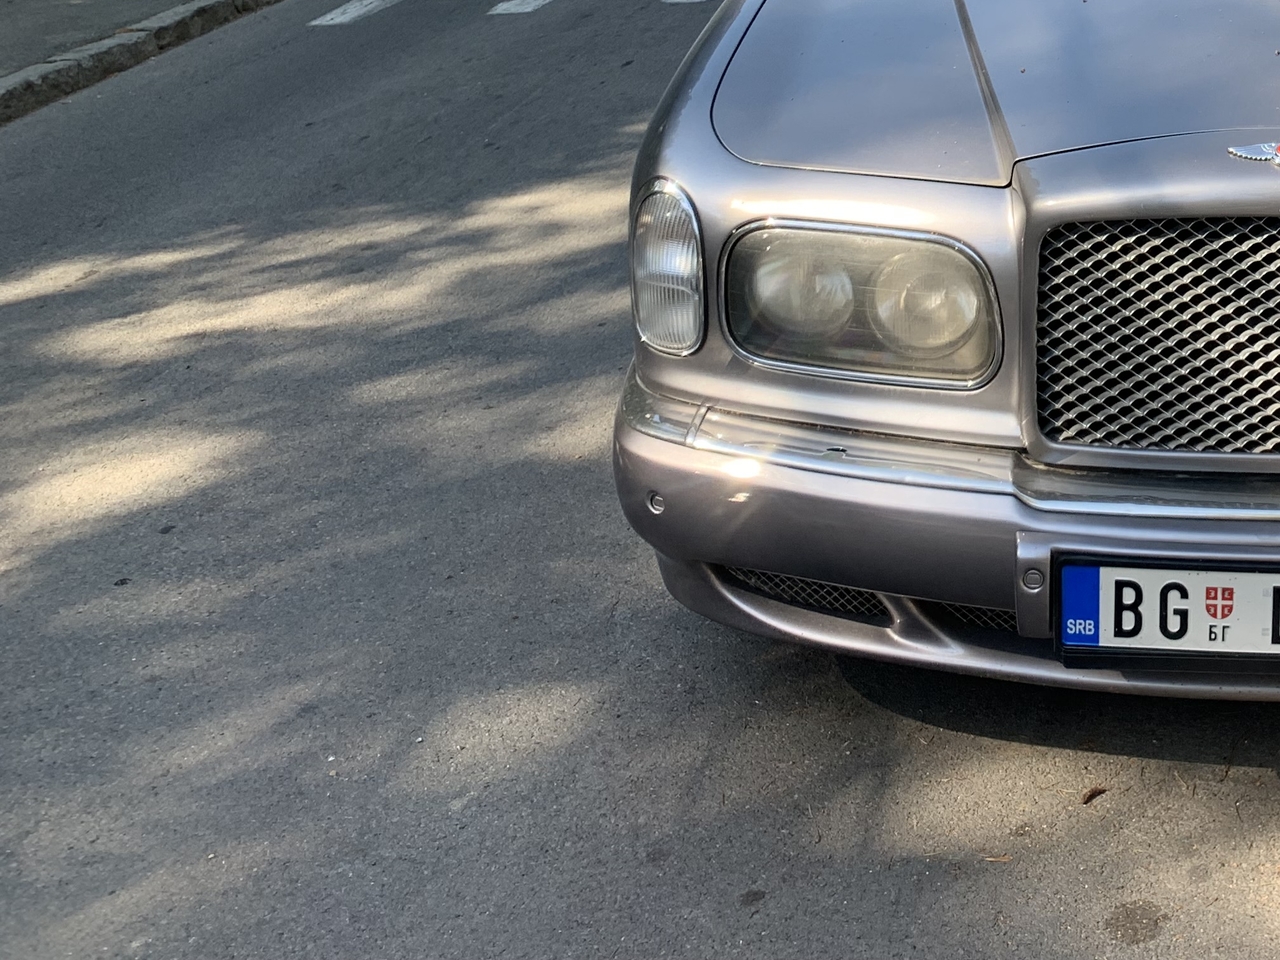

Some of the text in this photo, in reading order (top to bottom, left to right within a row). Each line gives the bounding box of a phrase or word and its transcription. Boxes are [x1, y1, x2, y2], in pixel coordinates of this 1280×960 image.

[1113, 578, 1189, 640] BG
[1066, 619, 1095, 635] SRB
[1208, 624, 1231, 642] БГ
